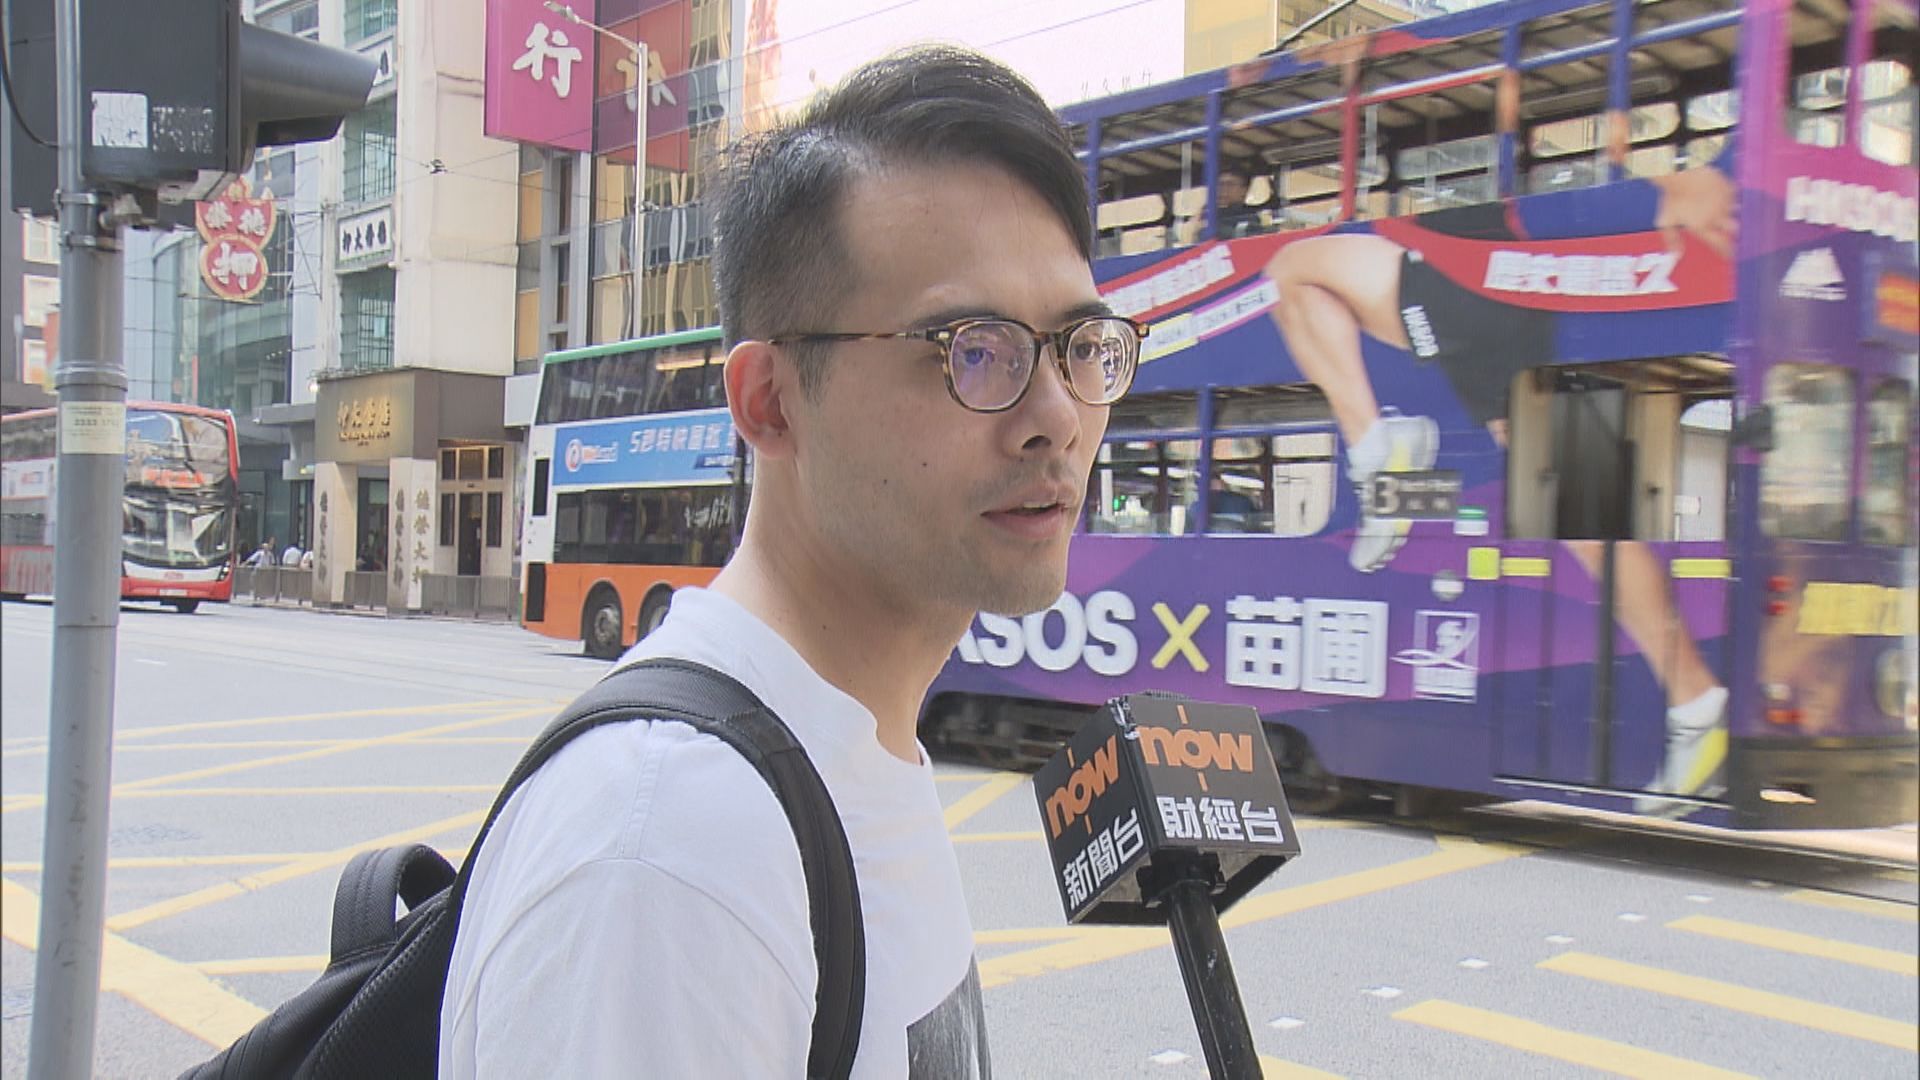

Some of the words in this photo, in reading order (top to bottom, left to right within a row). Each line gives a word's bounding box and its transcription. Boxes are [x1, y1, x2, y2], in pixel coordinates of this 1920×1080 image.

[511, 22, 583, 98] 行
[957, 590, 1138, 677] SOS
[1226, 594, 1389, 698] 苗圃
[1045, 735, 1120, 840] now
[1135, 725, 1253, 773] now
[1062, 807, 1145, 911] 新聞台
[1155, 795, 1285, 844] 財經台
